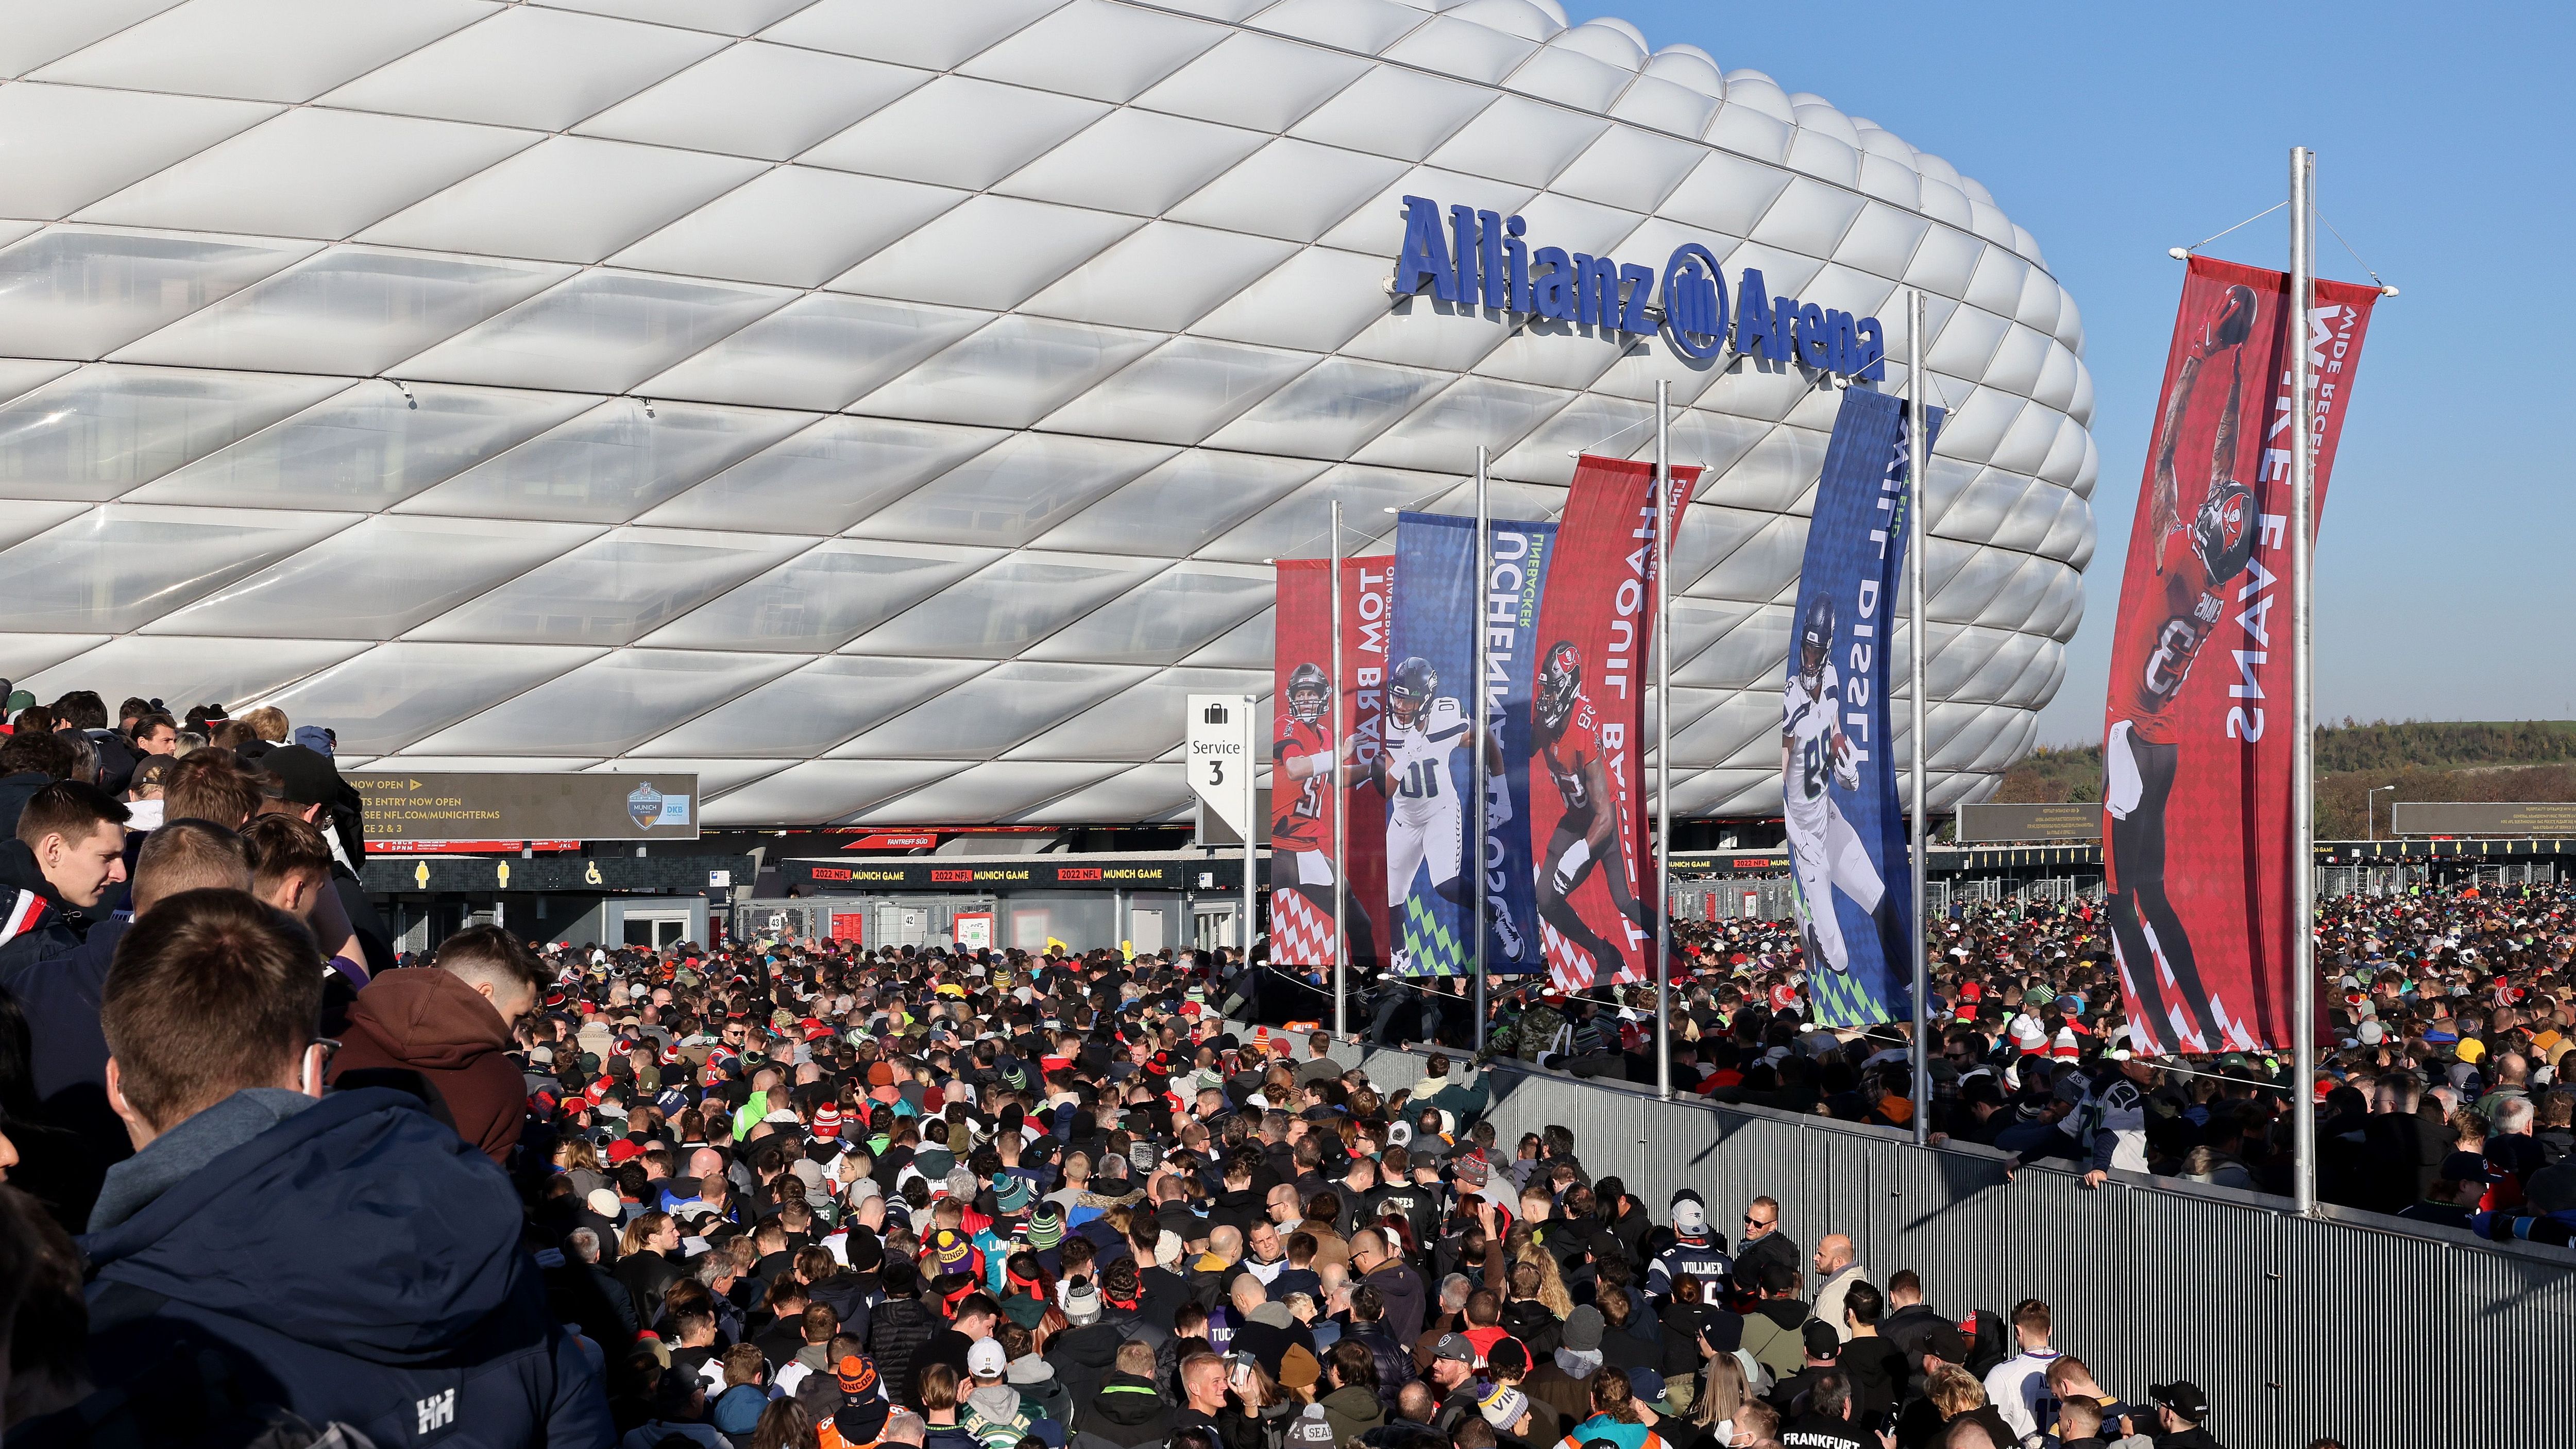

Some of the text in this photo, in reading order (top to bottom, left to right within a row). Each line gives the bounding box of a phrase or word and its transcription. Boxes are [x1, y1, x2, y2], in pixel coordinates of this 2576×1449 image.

[1395, 194, 1886, 382] Allianz Arena
[1193, 740, 1240, 754] Service
[1209, 760, 1224, 786] 3
[377, 780, 403, 789] OPEN
[376, 797, 407, 806] ENTRY
[409, 797, 433, 806] NOW
[435, 797, 461, 806] OPEN
[364, 810, 500, 820] SEE NFL.COM/MUNICHTERMS
[378, 824, 384, 833] 2
[386, 824, 394, 833] &
[396, 824, 402, 833] 3
[816, 869, 904, 880] 2022 NFL MUNICH GAME
[935, 871, 953, 880] 2022
[973, 871, 1004, 880] MUNICH
[1006, 871, 1029, 880] GAME
[1062, 869, 1162, 879] 2022 NFL MUNICH GAME
[771, 919, 779, 927] 43
[906, 916, 913, 925] 42
[1681, 1262, 1724, 1275] VOLLMER
[416, 1388, 455, 1435] HH
[1783, 1433, 1861, 1449] FRANKFURT
